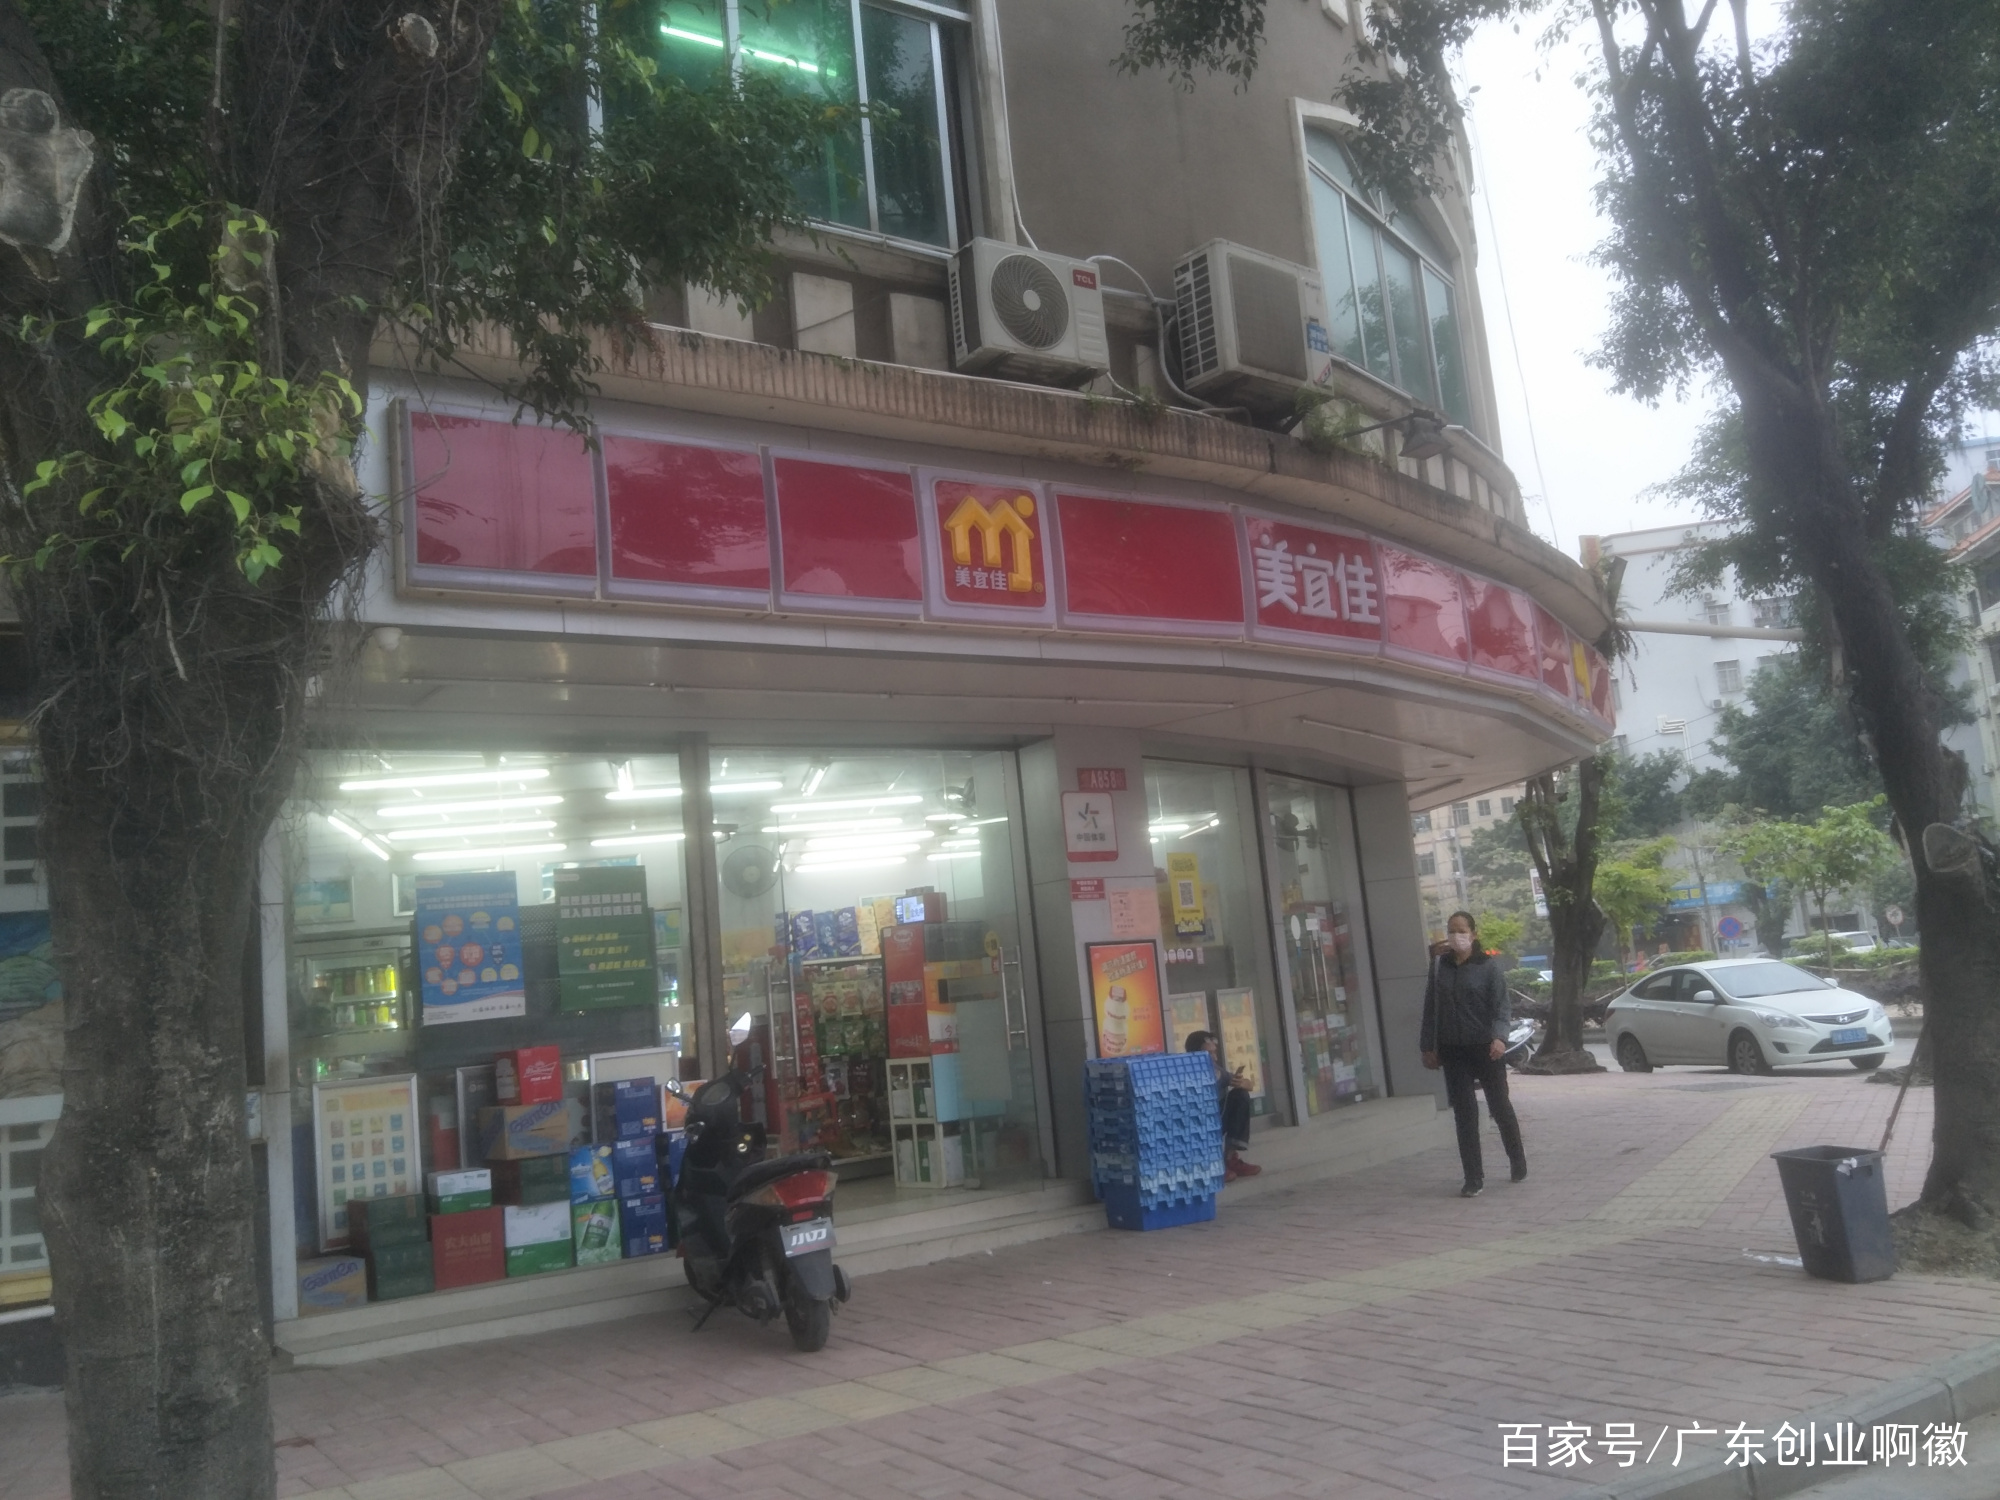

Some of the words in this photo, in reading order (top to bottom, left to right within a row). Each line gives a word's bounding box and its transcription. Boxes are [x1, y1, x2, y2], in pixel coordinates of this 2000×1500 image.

[1075, 273, 1095, 286] TCL
[954, 565, 1008, 591] 美宜佳
[1254, 532, 1381, 625] 美宜佳
[1090, 769, 1117, 789] A858
